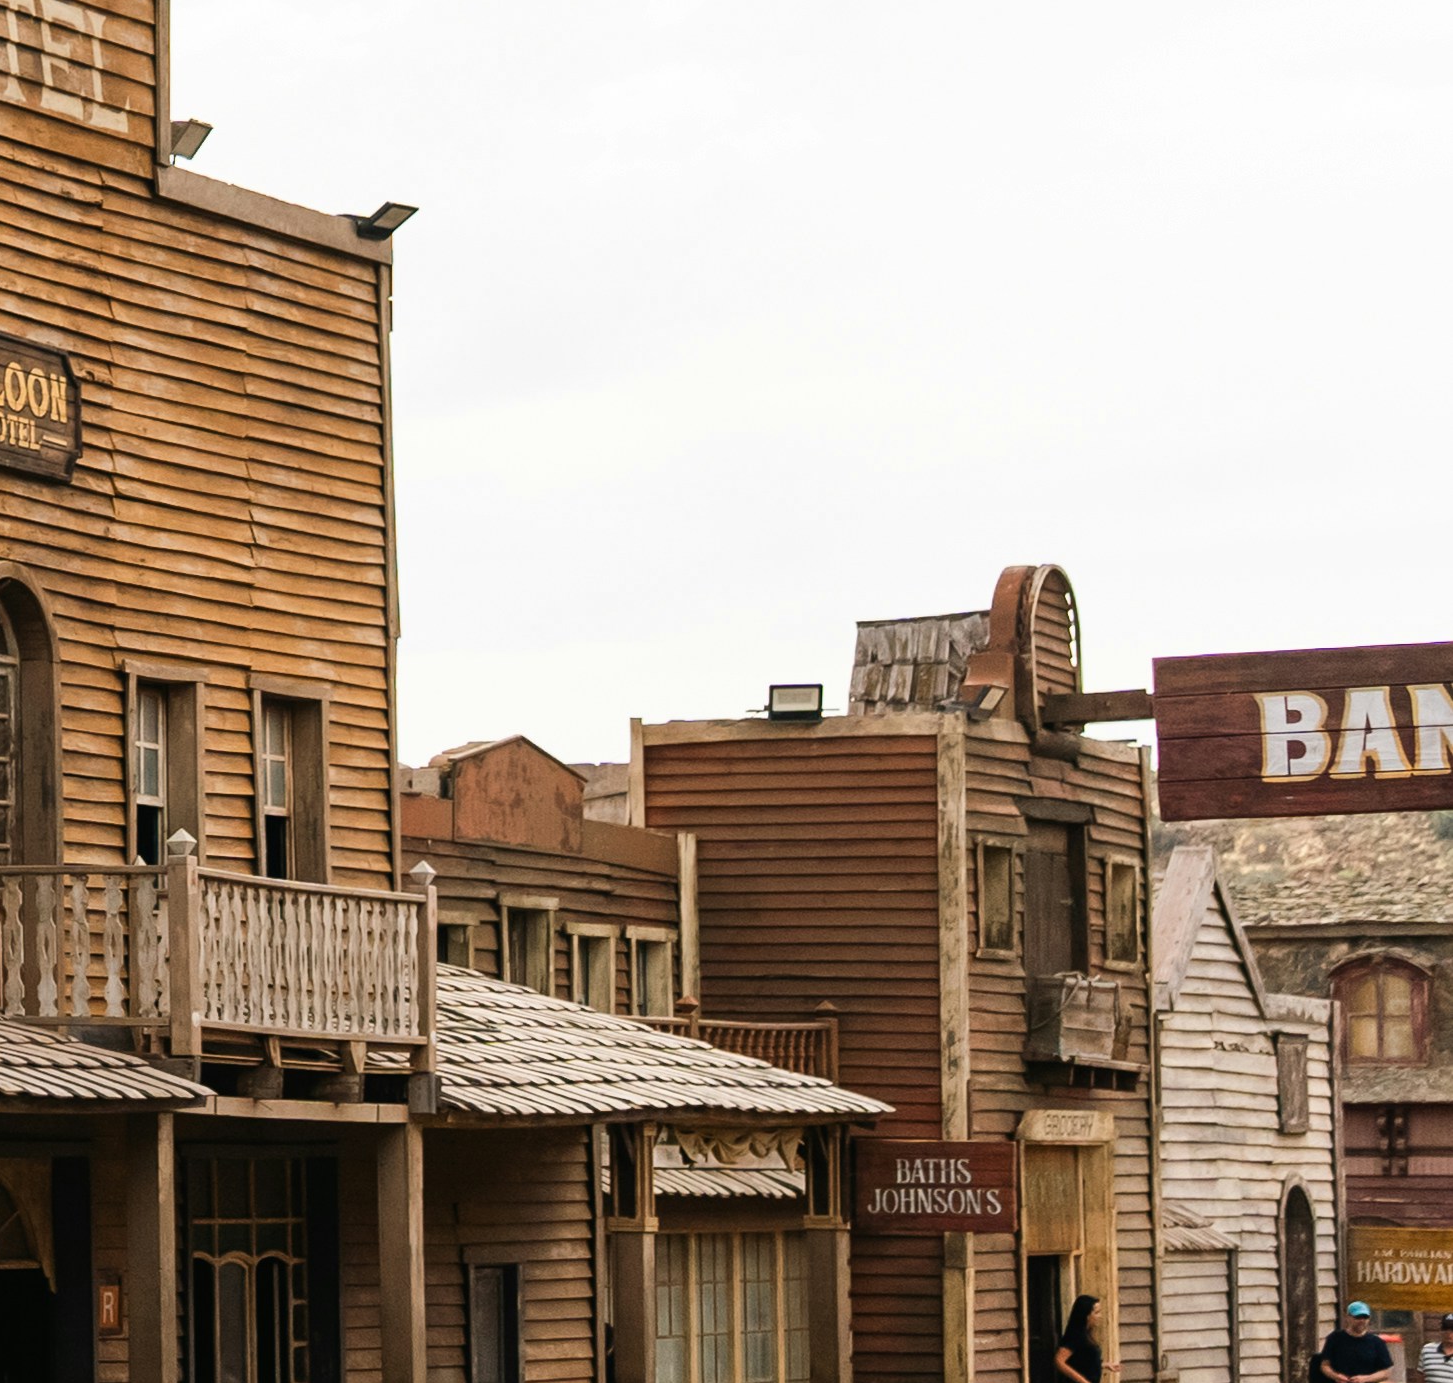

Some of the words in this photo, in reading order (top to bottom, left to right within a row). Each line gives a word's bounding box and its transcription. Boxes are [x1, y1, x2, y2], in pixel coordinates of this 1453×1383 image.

[895, 1157, 973, 1185] BATHS
[867, 1187, 1003, 1215] JOHNSON'S
[102, 1291, 114, 1324] R
